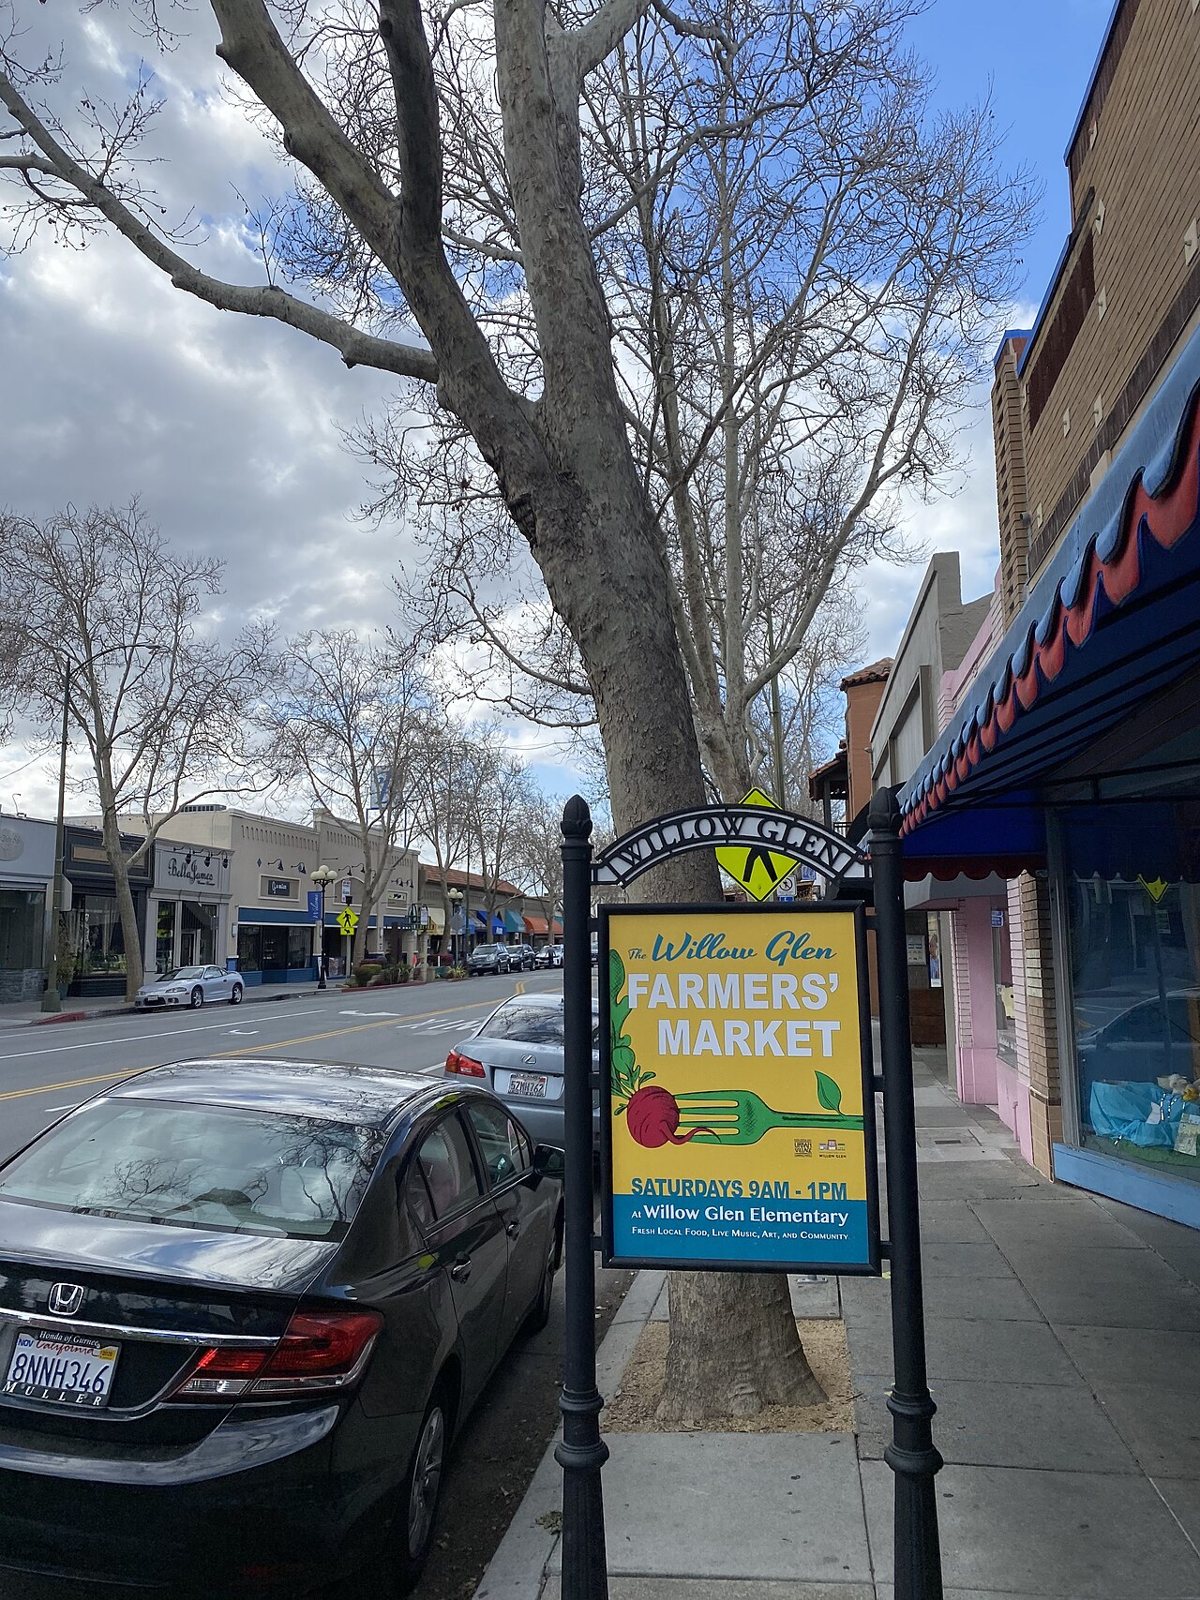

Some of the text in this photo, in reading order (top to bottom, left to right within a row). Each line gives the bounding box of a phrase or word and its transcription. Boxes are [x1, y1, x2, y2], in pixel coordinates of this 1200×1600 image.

[616, 816, 843, 871] WILLOW GLEN
[168, 858, 194, 880] Bella
[628, 930, 837, 966] The Willow Glen
[627, 973, 839, 1010] FARMERS’
[657, 1019, 841, 1057] MARKET
[631, 1177, 743, 1198] SATURDAYS
[749, 1180, 790, 1199] 9AM
[807, 1182, 847, 1200] 1PM
[643, 1204, 700, 1220] Willow
[704, 1205, 745, 1221] Glen
[750, 1206, 849, 1227] Elementary
[632, 1226, 655, 1235] FRESH
[657, 1227, 682, 1235] LOCAL
[685, 1227, 710, 1238] FOOD,
[712, 1228, 729, 1237] LIVE
[731, 1229, 760, 1239] MUSIC,
[761, 1230, 780, 1240] ART,
[800, 1231, 848, 1240] COMMUNITY
[17, 1338, 34, 1347] NOV
[35, 1340, 96, 1356] California
[39, 1330, 63, 1341] Honda
[64, 1335, 71, 1344] of
[12, 1353, 110, 1394] 8NNH346
[2, 1380, 102, 1406] MULLER
